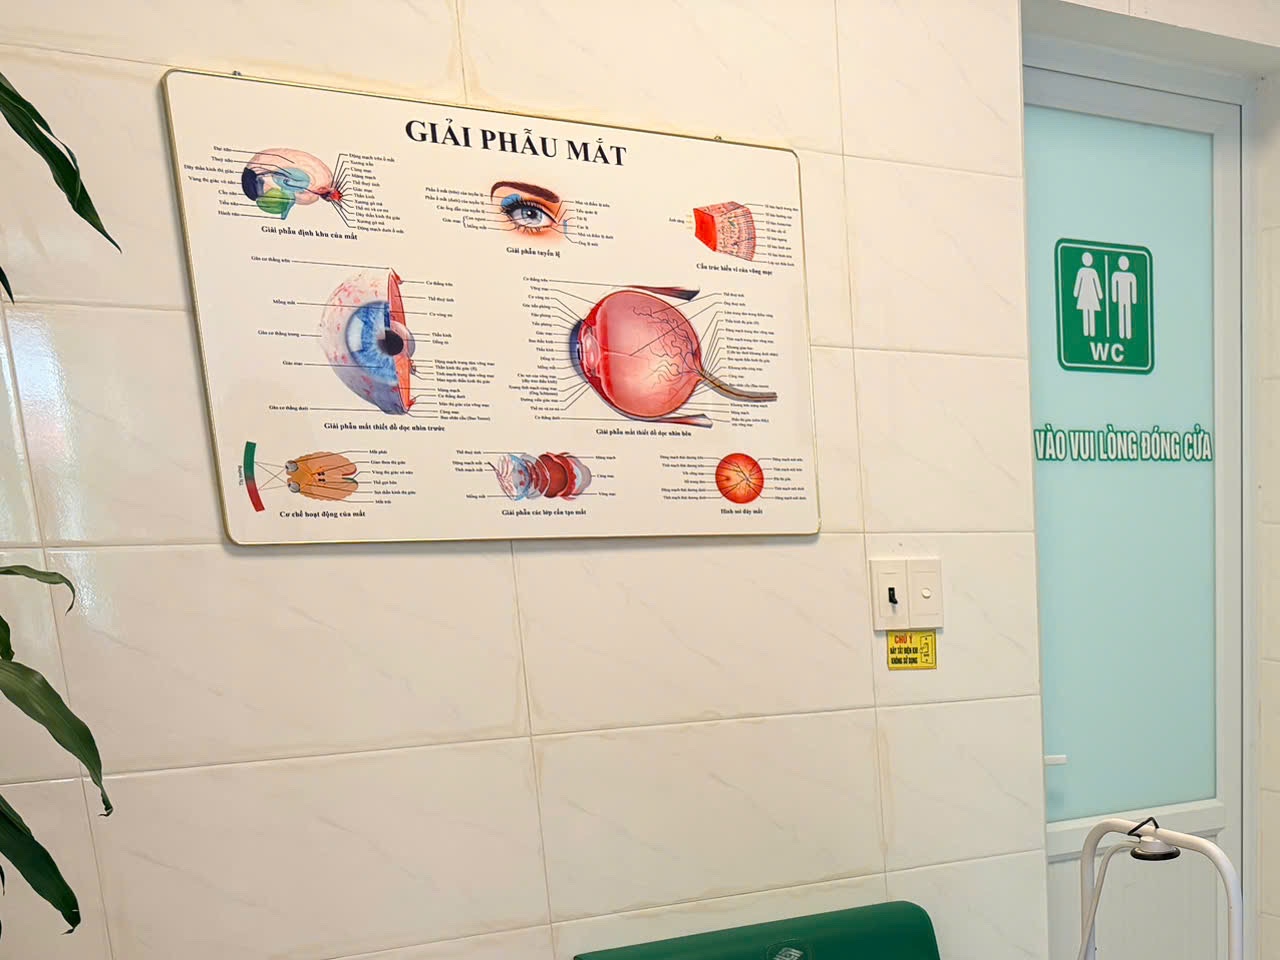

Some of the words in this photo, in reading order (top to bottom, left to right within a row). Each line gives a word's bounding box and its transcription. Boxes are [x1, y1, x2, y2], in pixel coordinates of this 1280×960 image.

[405, 118, 472, 148] GIẢI
[480, 128, 557, 157] PHẪU
[566, 138, 627, 166] MẮT
[314, 230, 329, 238] khu
[1090, 341, 1125, 363] WC
[1033, 423, 1066, 461] VÀO
[1069, 430, 1095, 461] VUI
[1098, 424, 1138, 461] LÒNG
[1139, 425, 1181, 461] ĐÓNG
[1183, 423, 1213, 461] CỬA
[291, 509, 303, 517] chế
[321, 510, 338, 518] động
[352, 509, 365, 517] mắt
